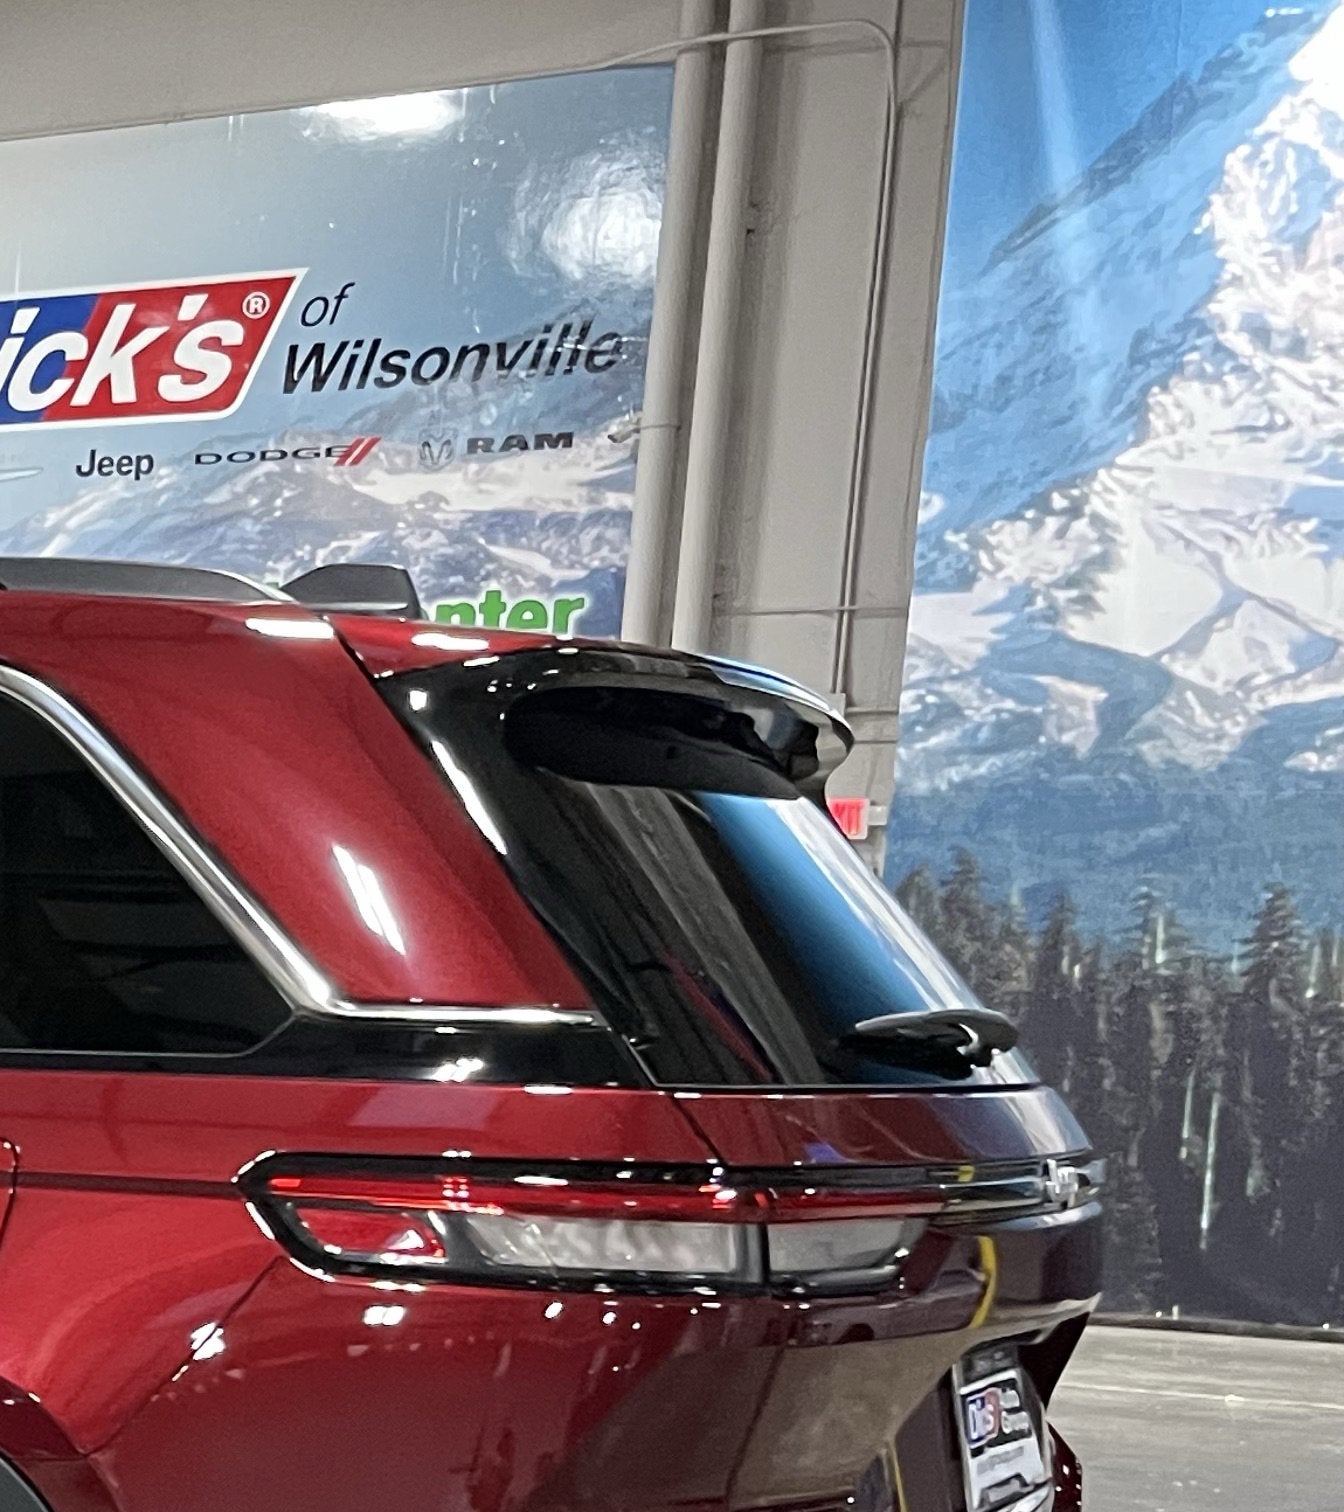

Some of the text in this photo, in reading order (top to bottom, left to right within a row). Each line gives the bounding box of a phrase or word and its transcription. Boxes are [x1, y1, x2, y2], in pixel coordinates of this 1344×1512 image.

[300, 282, 355, 327] of
[282, 316, 623, 394] Wilsonville
[75, 431, 575, 480] Jeep DODGE RAM
